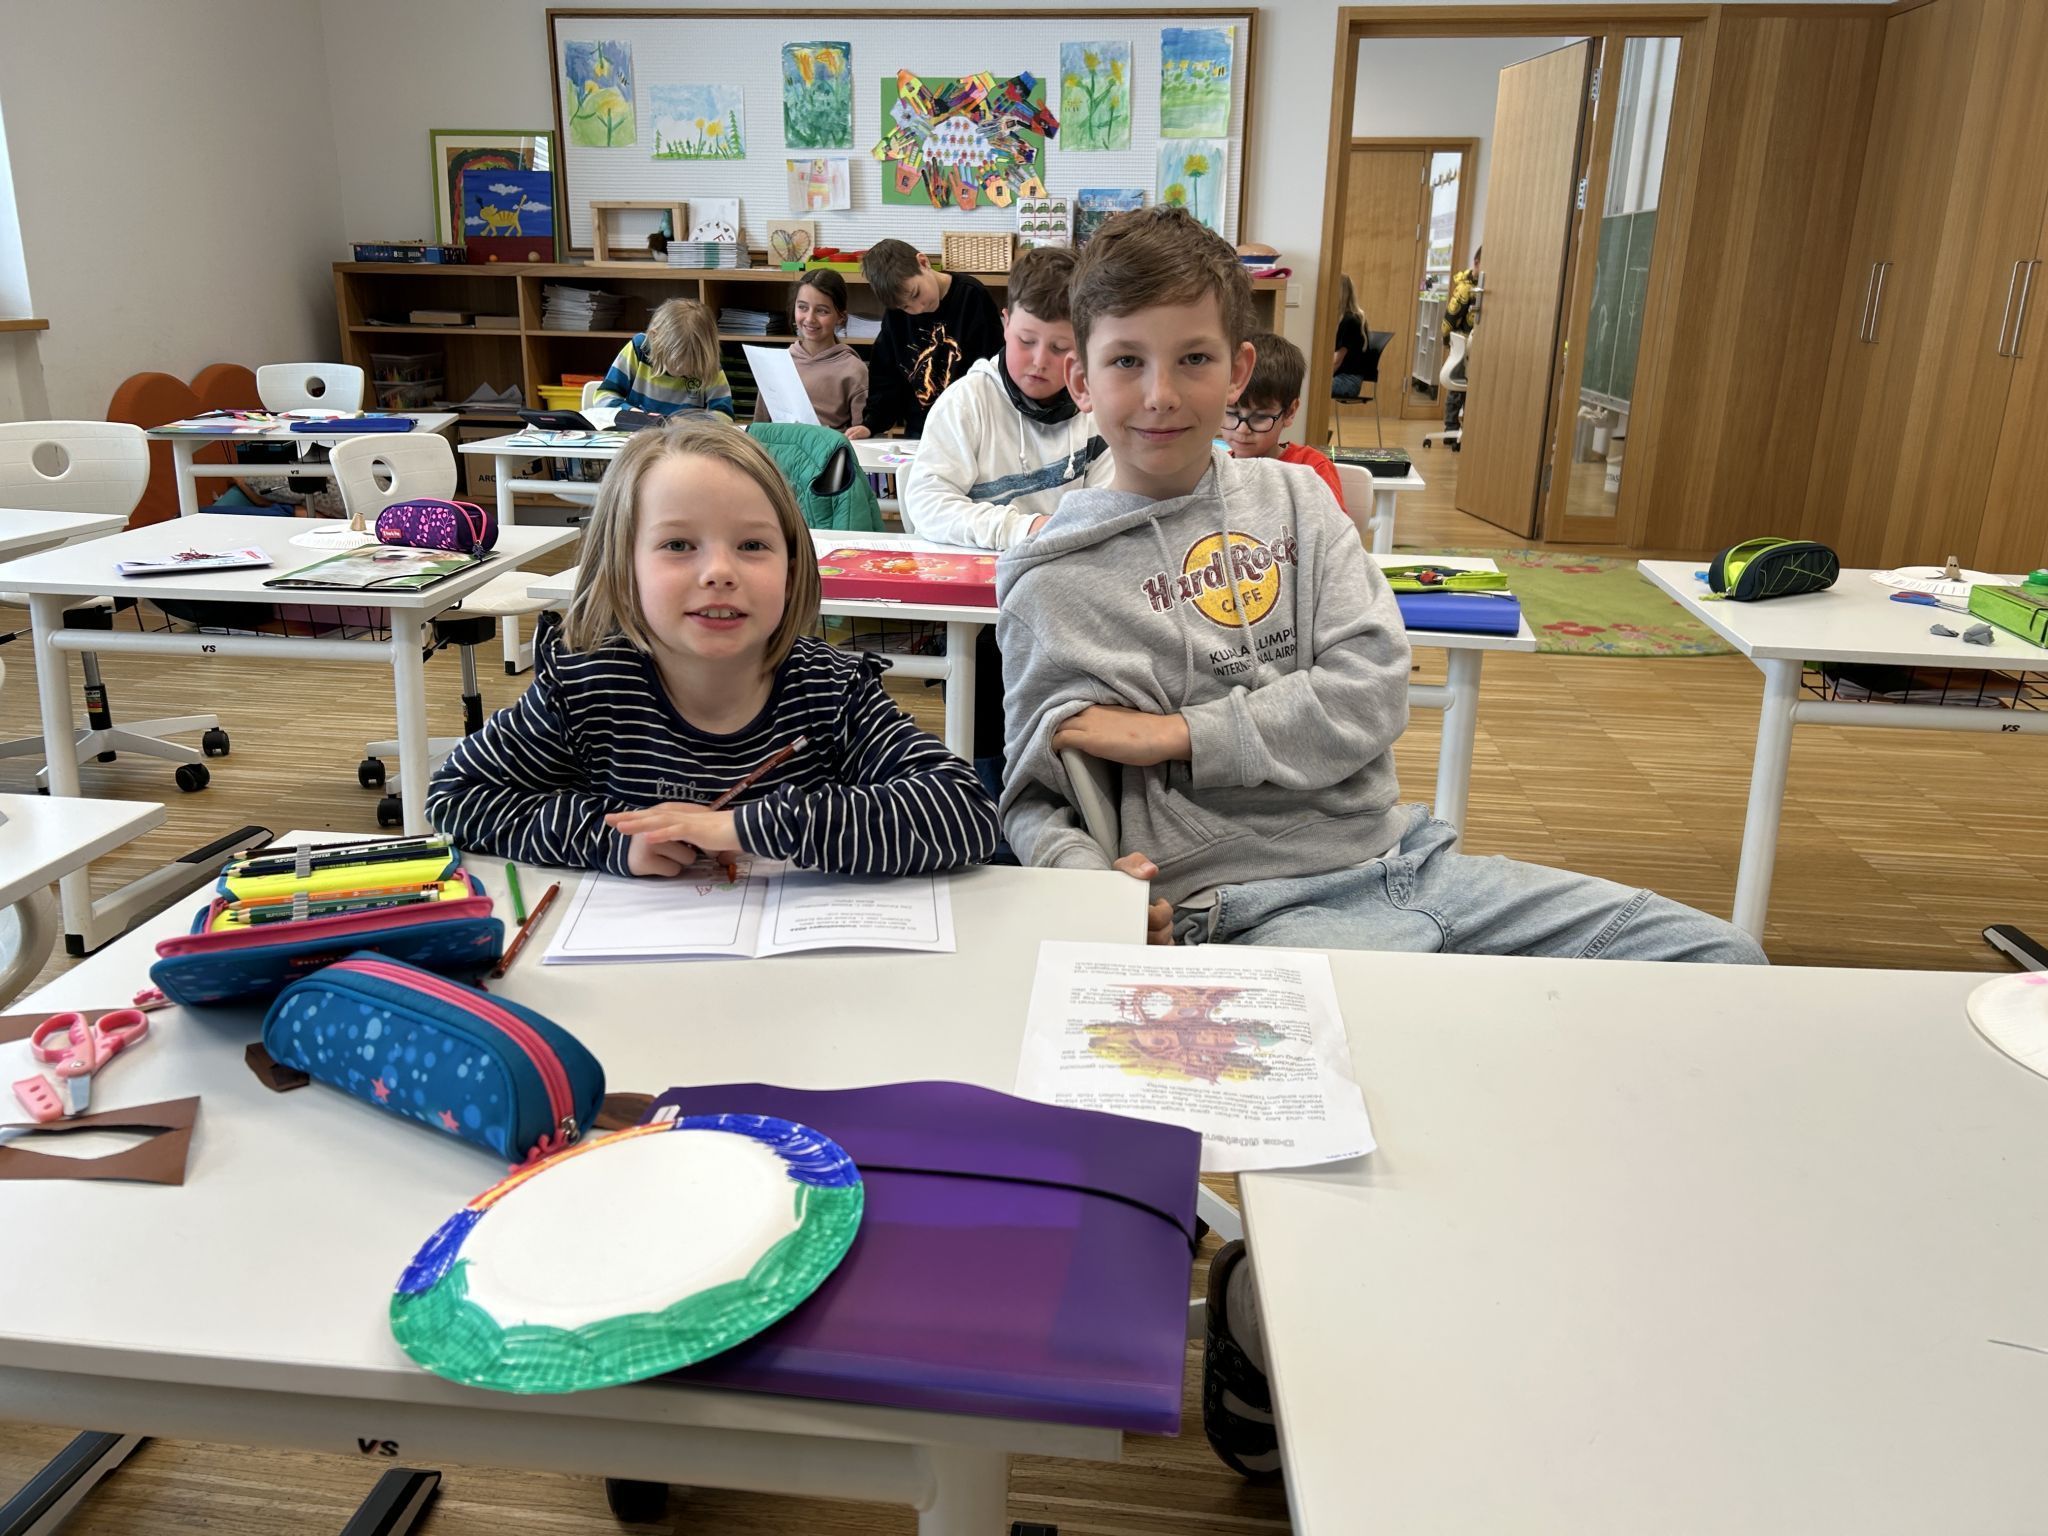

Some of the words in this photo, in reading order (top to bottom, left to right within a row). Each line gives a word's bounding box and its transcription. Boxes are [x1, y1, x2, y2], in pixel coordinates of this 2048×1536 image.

[1142, 551, 1226, 612] Hard
[1230, 526, 1297, 582] Rock
[201, 644, 217, 653] VS
[1209, 645, 1251, 664] KUALA
[2001, 724, 2021, 732] VS
[357, 1437, 399, 1457] VS
